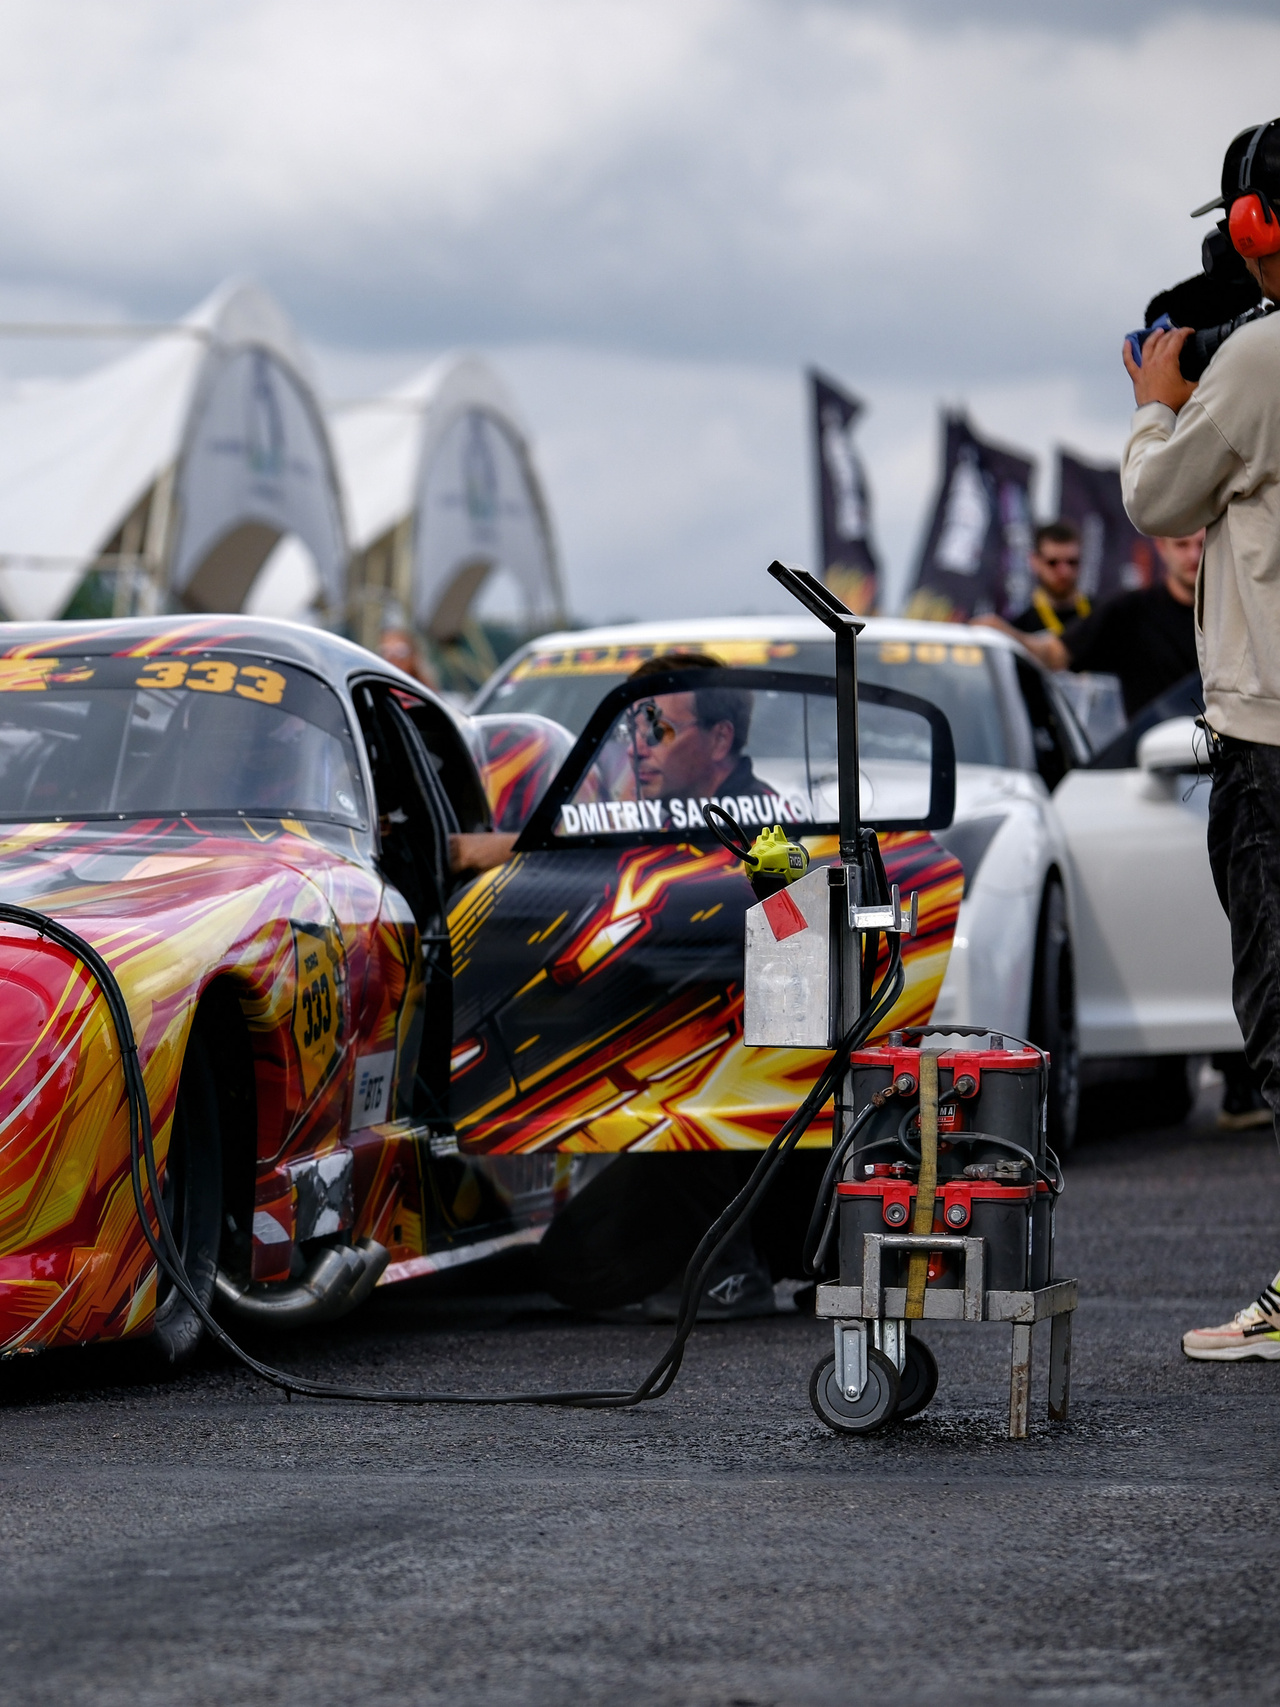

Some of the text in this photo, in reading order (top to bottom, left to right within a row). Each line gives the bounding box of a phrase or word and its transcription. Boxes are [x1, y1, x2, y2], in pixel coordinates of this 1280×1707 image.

[135, 660, 287, 704] 333
[560, 799, 662, 834] DMITRIY
[302, 973, 332, 1049] 333
